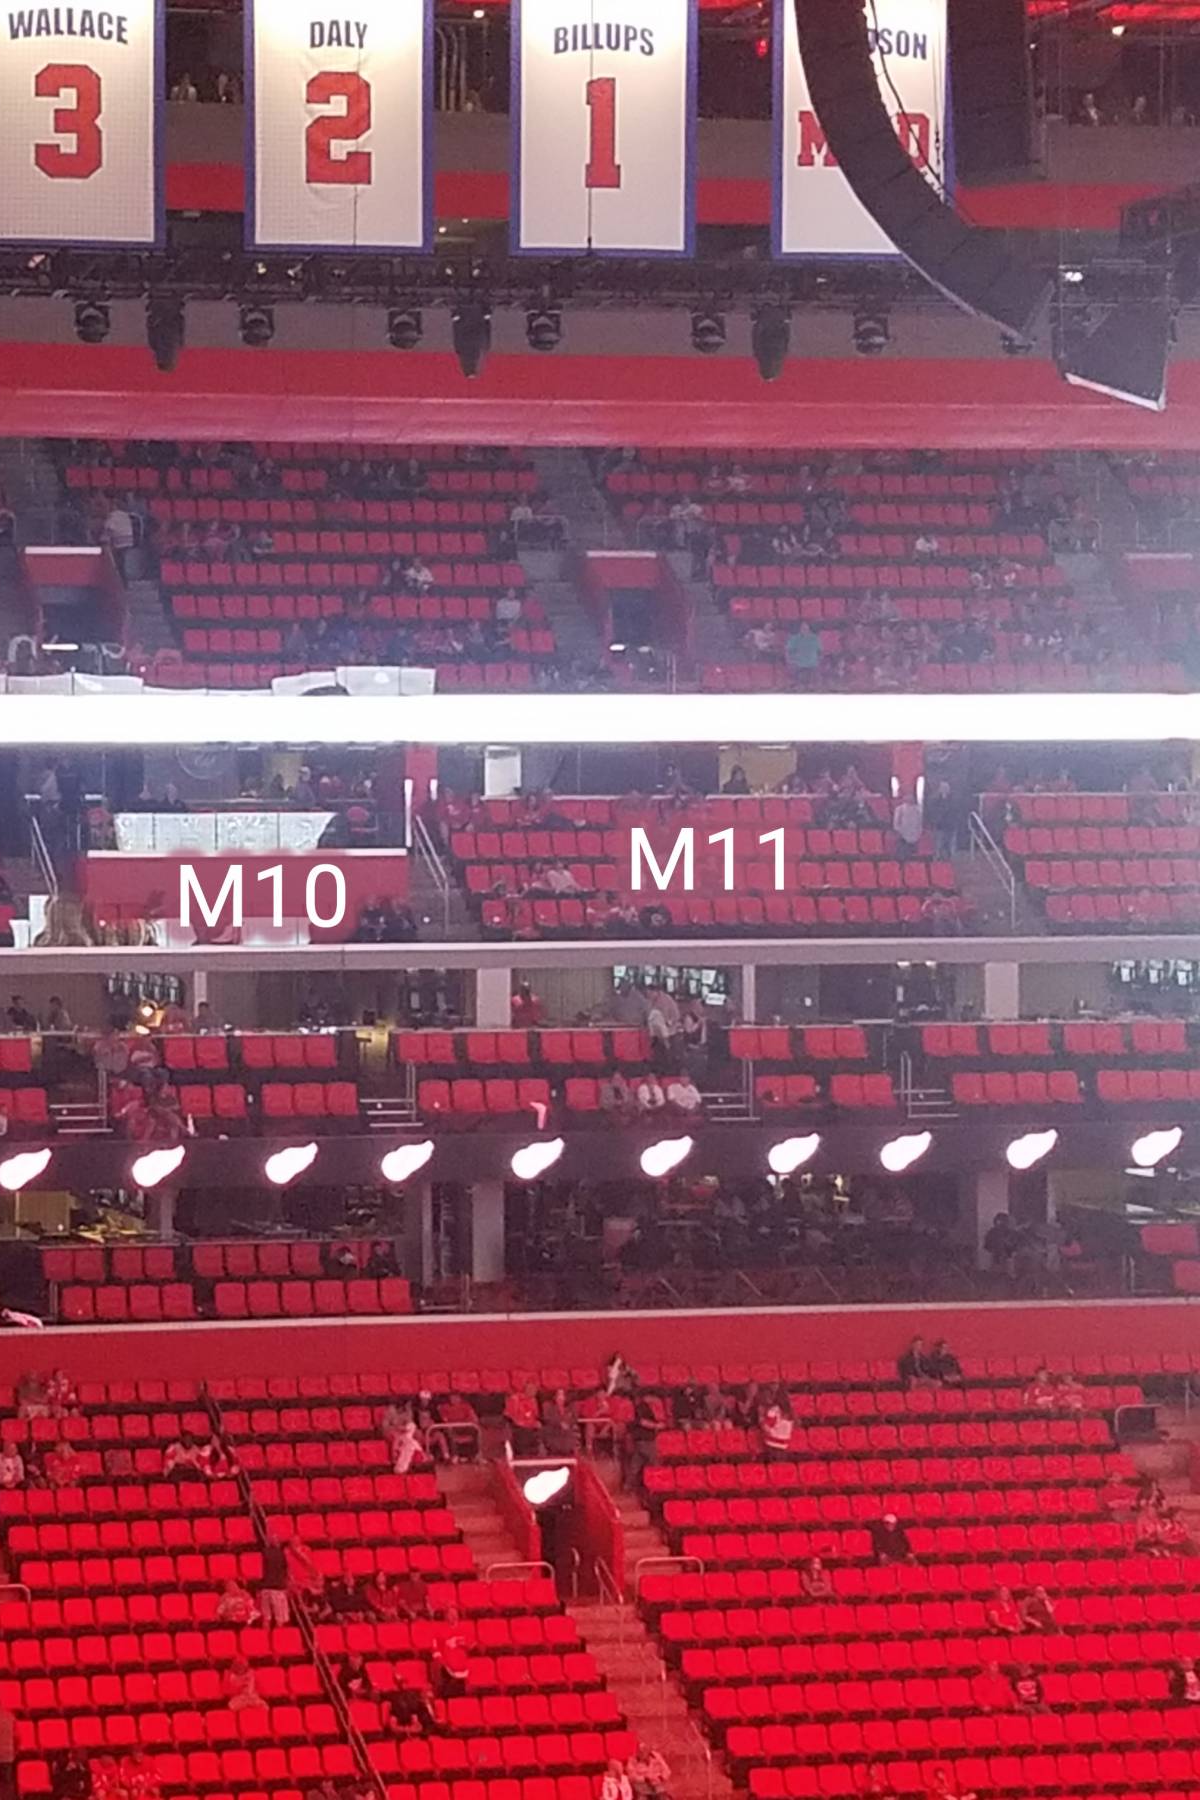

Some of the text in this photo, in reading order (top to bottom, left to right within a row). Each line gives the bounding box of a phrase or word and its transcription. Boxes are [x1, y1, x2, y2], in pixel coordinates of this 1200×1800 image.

[8, 8, 129, 46] WALLACE
[310, 20, 367, 48] DALY
[553, 25, 654, 58] BILLUPS
[34, 63, 102, 180] 3
[305, 71, 373, 185] 2
[585, 77, 621, 189] 1
